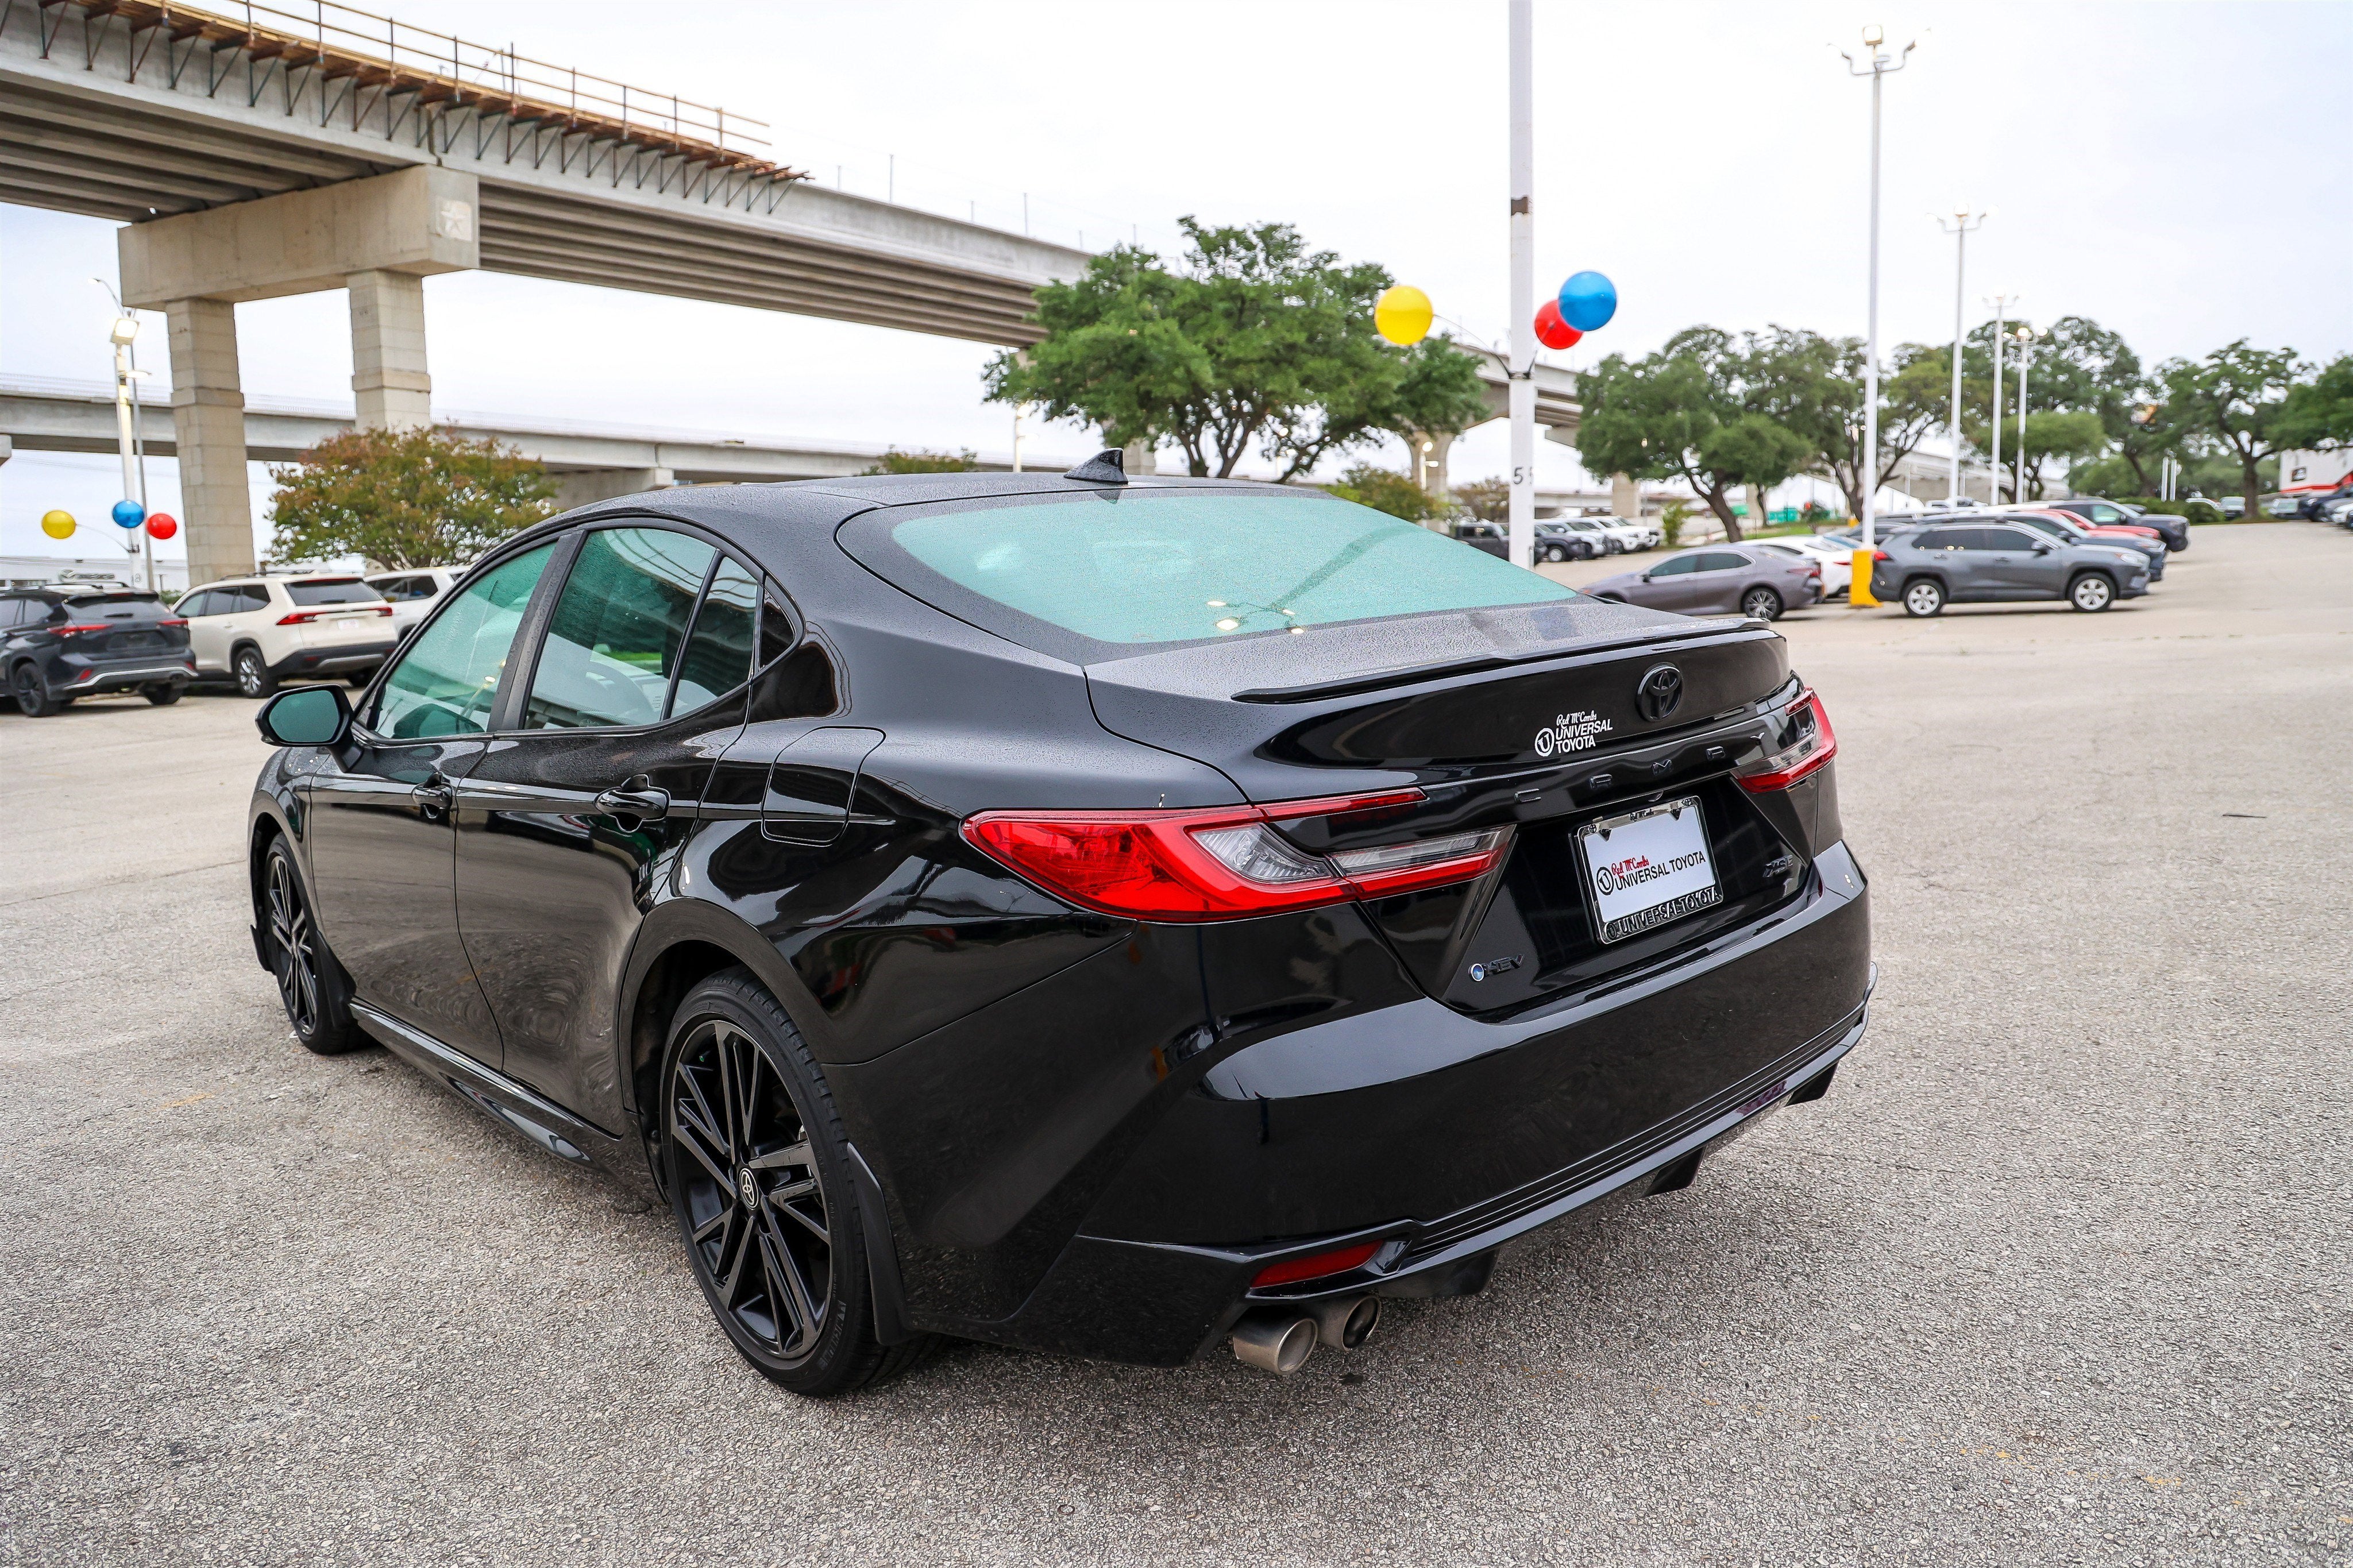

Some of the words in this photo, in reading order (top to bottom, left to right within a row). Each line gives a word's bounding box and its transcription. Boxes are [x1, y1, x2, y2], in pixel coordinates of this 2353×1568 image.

[1513, 466, 1523, 485] 5
[1556, 714, 1569, 729] Red
[1556, 719, 1613, 740] UNIVERSAL
[1556, 735, 1596, 754] TOYOTA
[1611, 862, 1625, 879] Red
[1615, 862, 1671, 891] UNIVERSAL
[1669, 851, 1706, 873] TOYOTA
[1618, 899, 1681, 934] UNIVERSAL
[1679, 886, 1721, 912] TOYOTA
